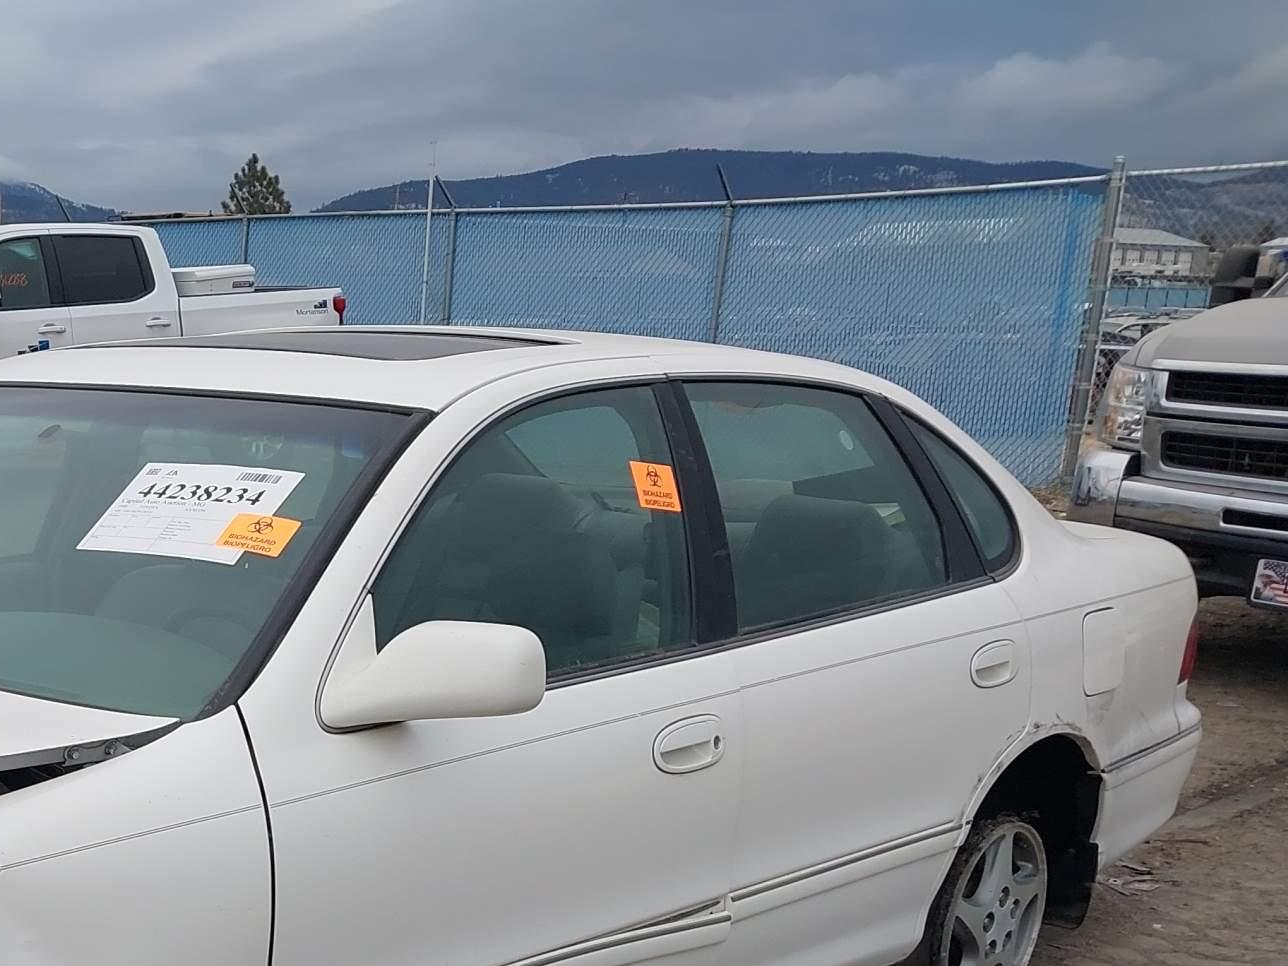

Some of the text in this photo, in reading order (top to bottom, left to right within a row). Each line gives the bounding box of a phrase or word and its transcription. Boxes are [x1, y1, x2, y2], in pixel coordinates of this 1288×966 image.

[138, 483, 266, 506] 44238234
[643, 490, 673, 499] BIOHAZARD
[223, 539, 271, 553] BIOPELIGRO
[228, 533, 277, 546] BIOHAZARD
